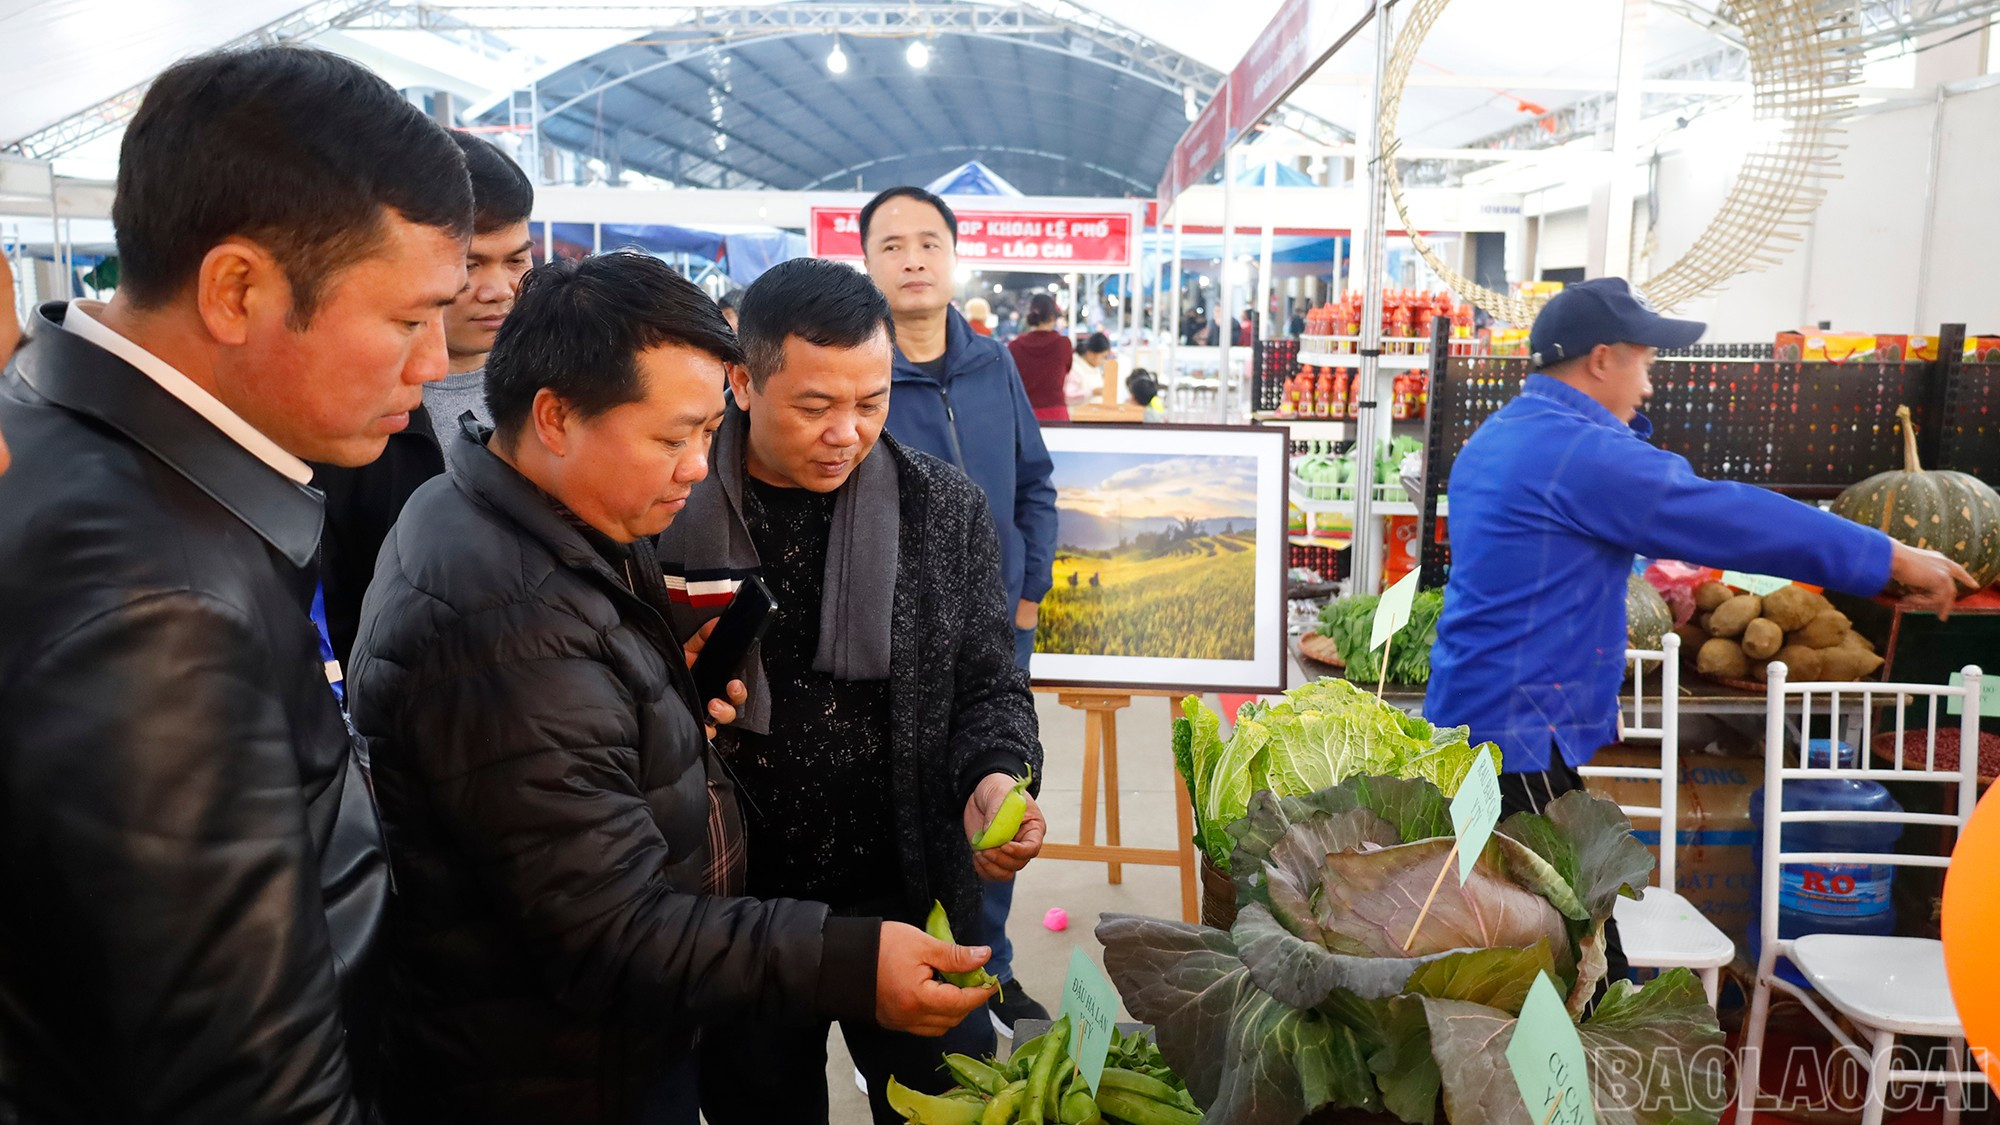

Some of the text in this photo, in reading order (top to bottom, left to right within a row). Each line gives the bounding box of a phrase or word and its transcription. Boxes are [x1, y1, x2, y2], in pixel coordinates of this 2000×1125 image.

[957, 220, 983, 236] OP
[987, 221, 1042, 237] KHOAI
[1045, 218, 1068, 240] LỆ
[1070, 219, 1110, 238] PHỐ
[1041, 242, 1074, 259] CAI
[1801, 869, 1856, 895] RO
[1071, 977, 1088, 1004] ĐẬU
[1094, 1006, 1109, 1034] LAN
